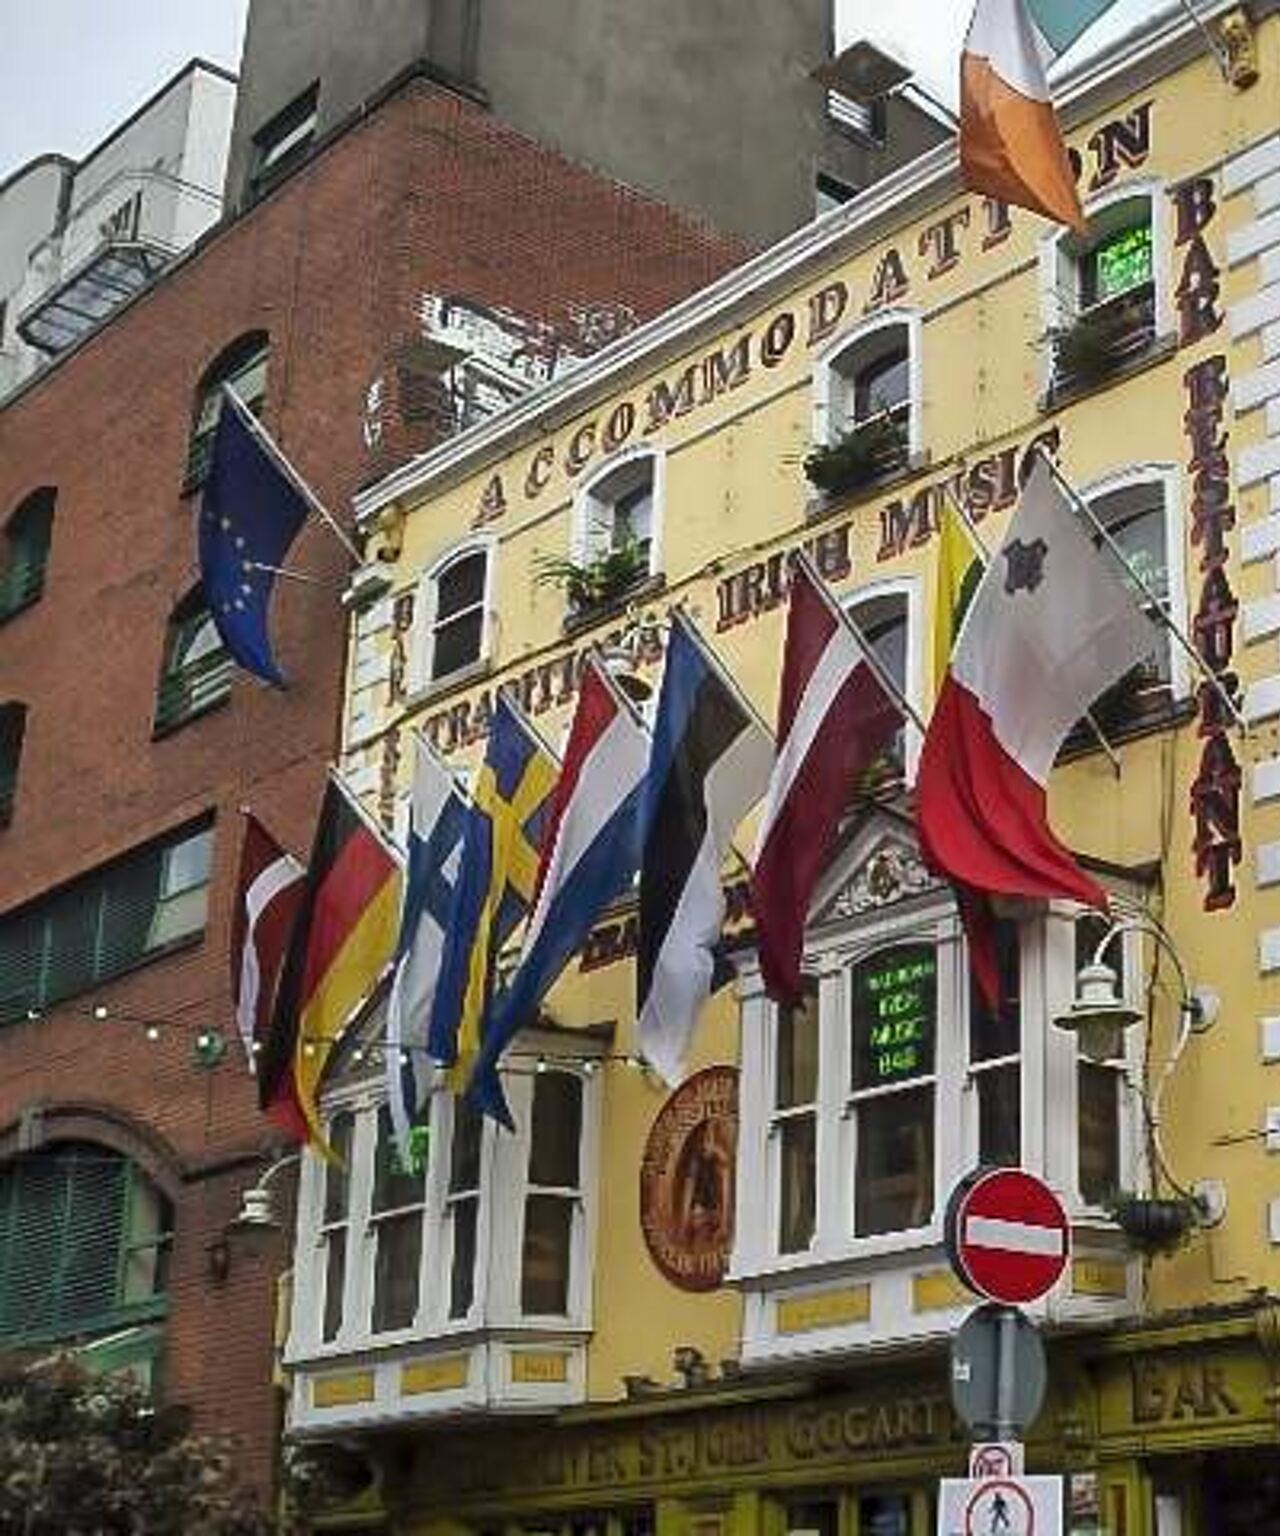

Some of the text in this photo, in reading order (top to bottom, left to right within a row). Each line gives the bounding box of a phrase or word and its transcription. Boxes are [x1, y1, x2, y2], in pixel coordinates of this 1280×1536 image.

[471, 101, 1154, 531] ACCOMMODATIN
[1171, 178, 1244, 912] BAR RESTAURANT
[786, 1394, 962, 1460] GOGART
[1131, 1353, 1240, 1423] BAR
